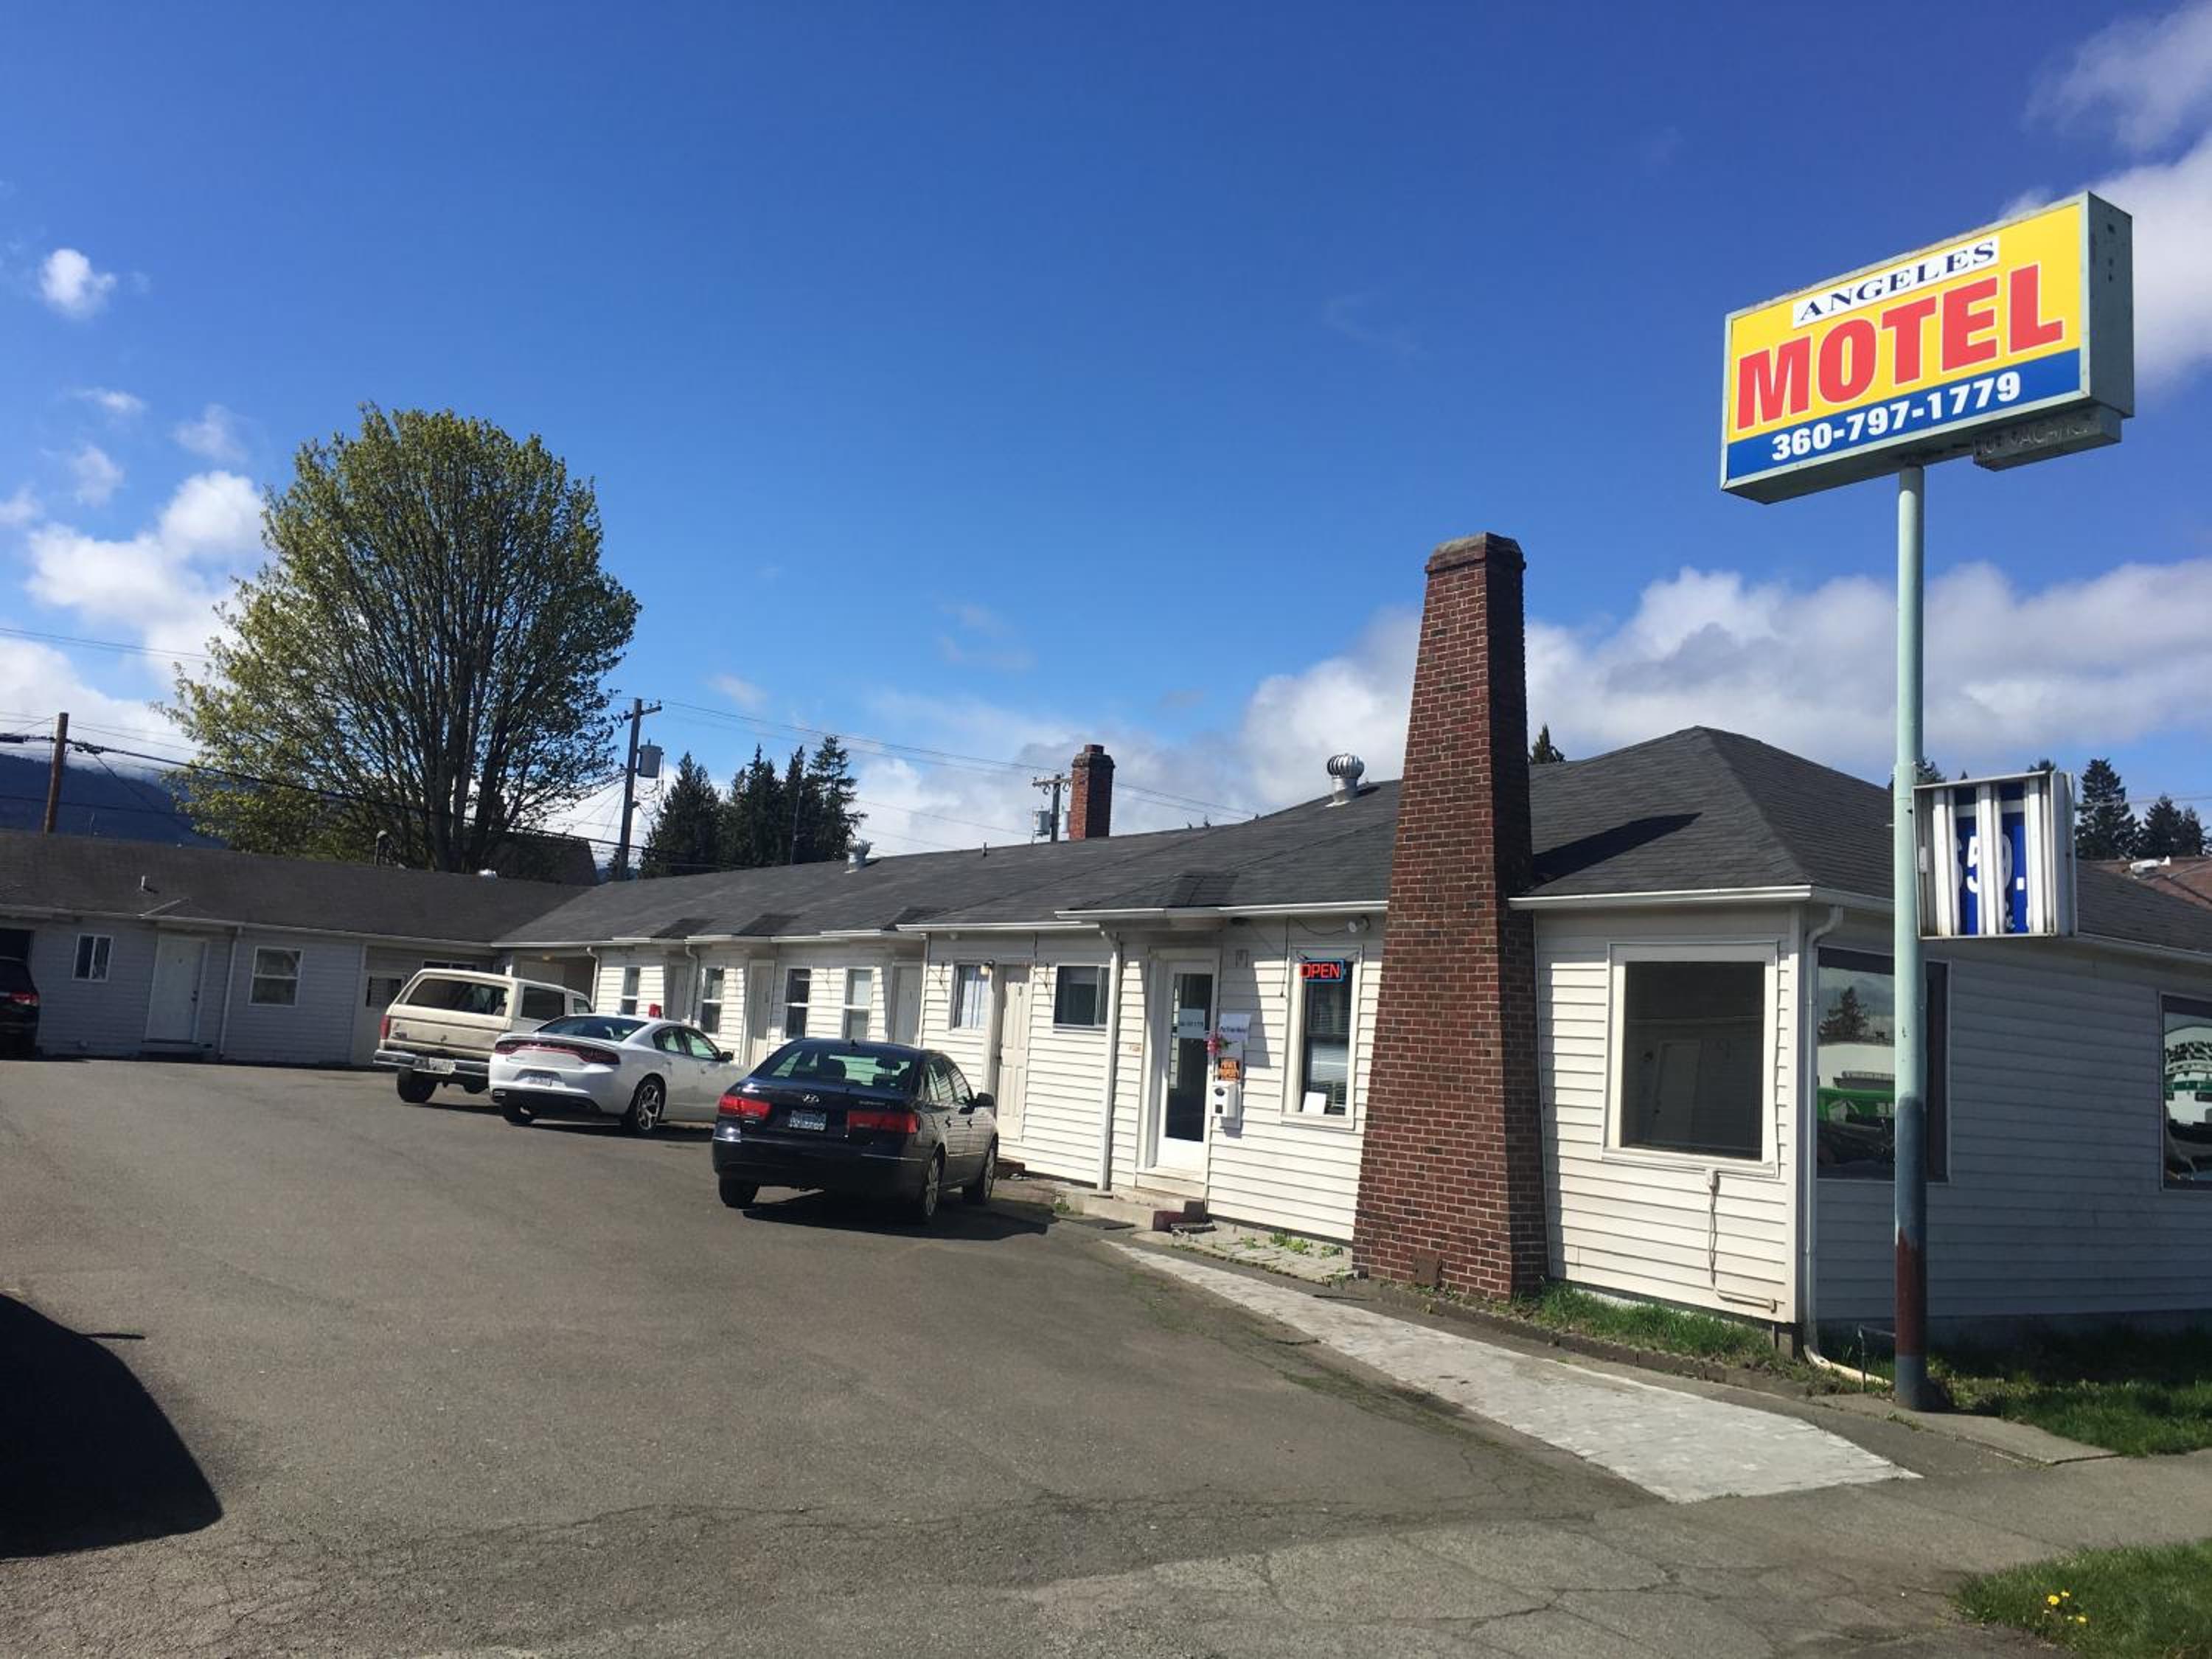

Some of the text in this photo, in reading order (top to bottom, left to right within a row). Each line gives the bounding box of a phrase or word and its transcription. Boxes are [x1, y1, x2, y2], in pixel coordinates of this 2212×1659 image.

[1800, 240, 1995, 321] ANGELES
[1736, 264, 2064, 431] MOTEL
[1771, 371, 2021, 462] 360-797-1779
[1301, 963, 1340, 978] OPEN
